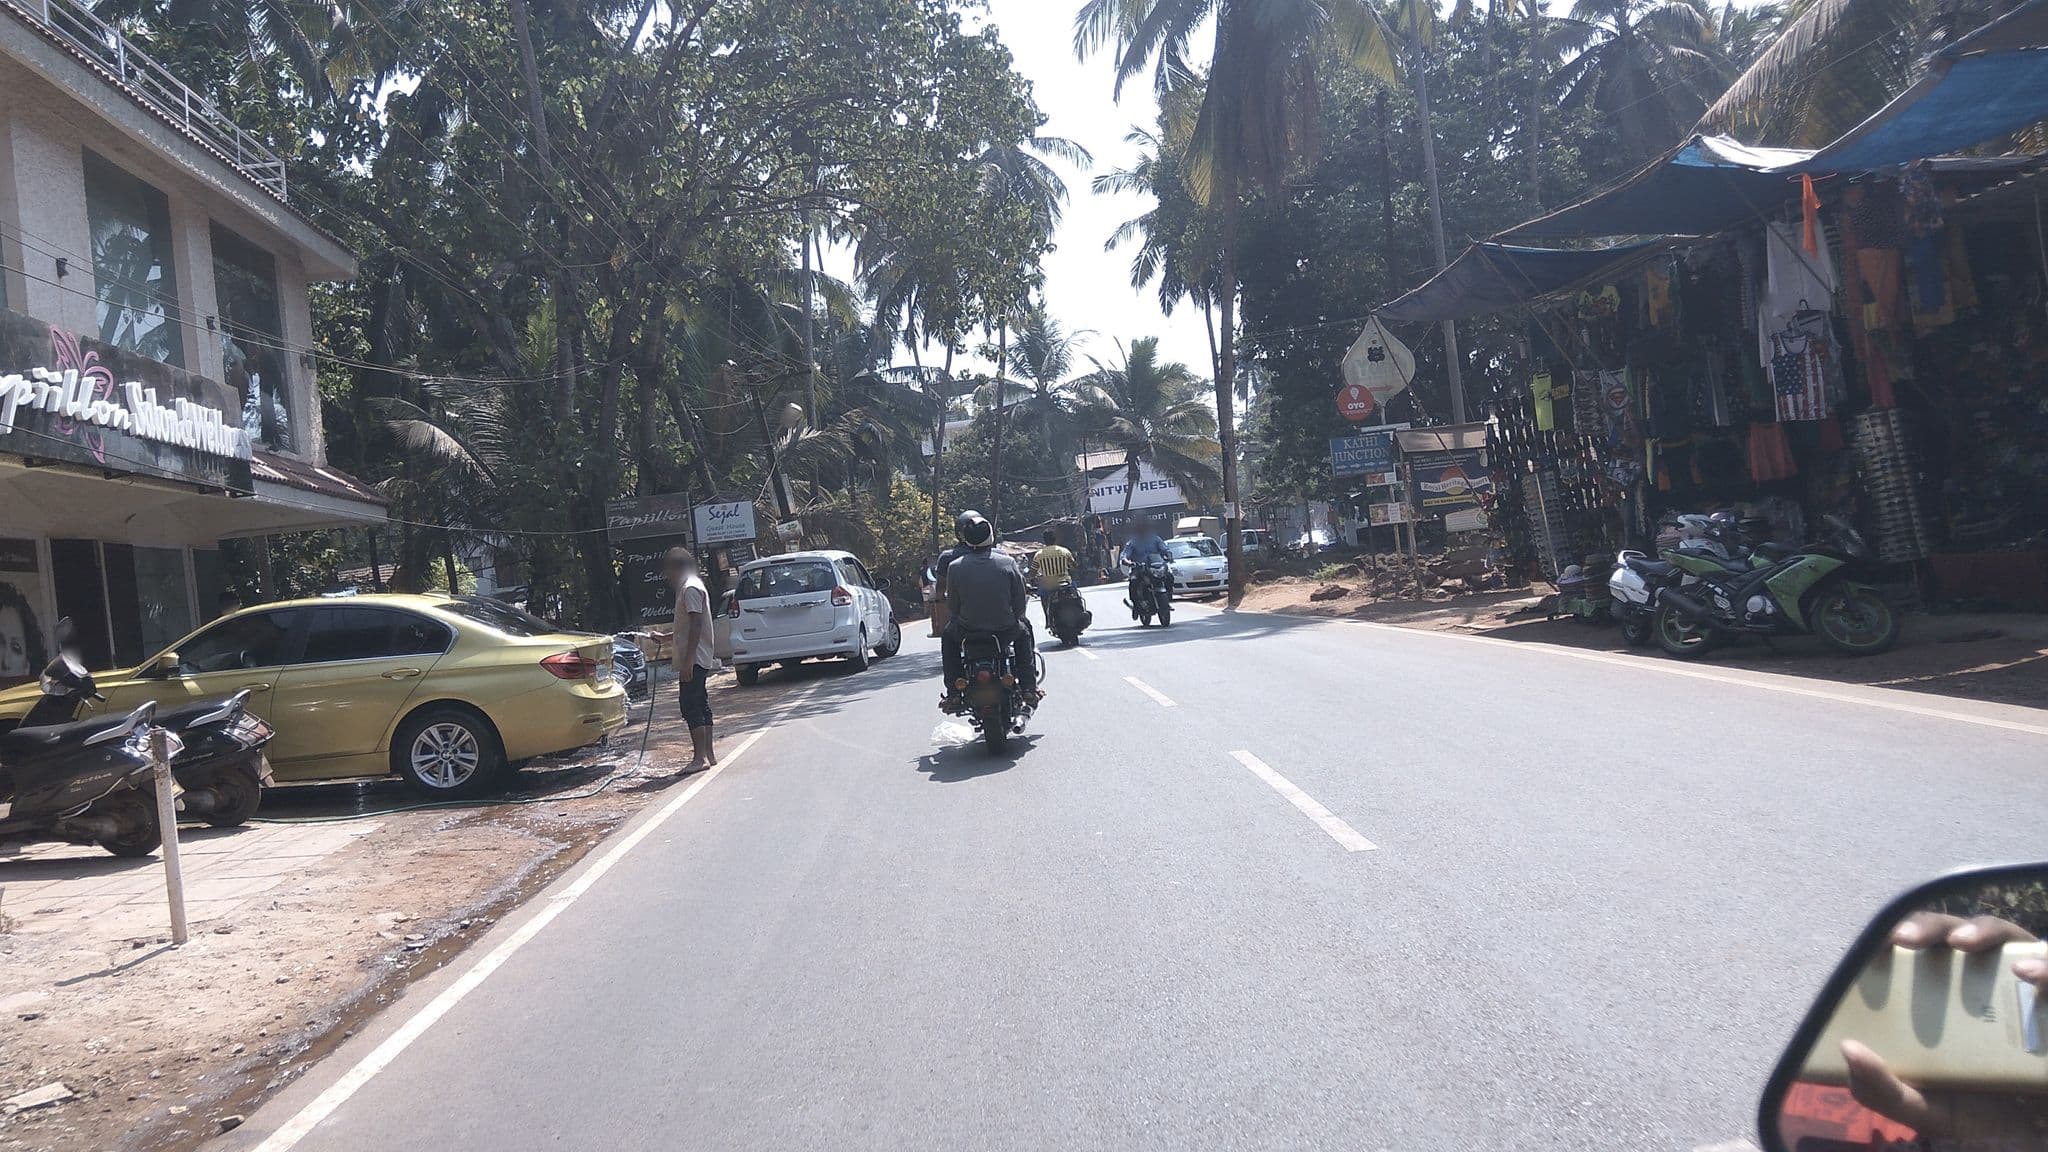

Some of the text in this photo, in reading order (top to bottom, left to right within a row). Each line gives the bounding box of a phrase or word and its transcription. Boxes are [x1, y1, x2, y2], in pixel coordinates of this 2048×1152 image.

[1347, 402, 1365, 410] OYO
[1343, 437, 1378, 450] KATHI
[1334, 447, 1389, 463] JUNCTION
[709, 504, 740, 524] Sejal
